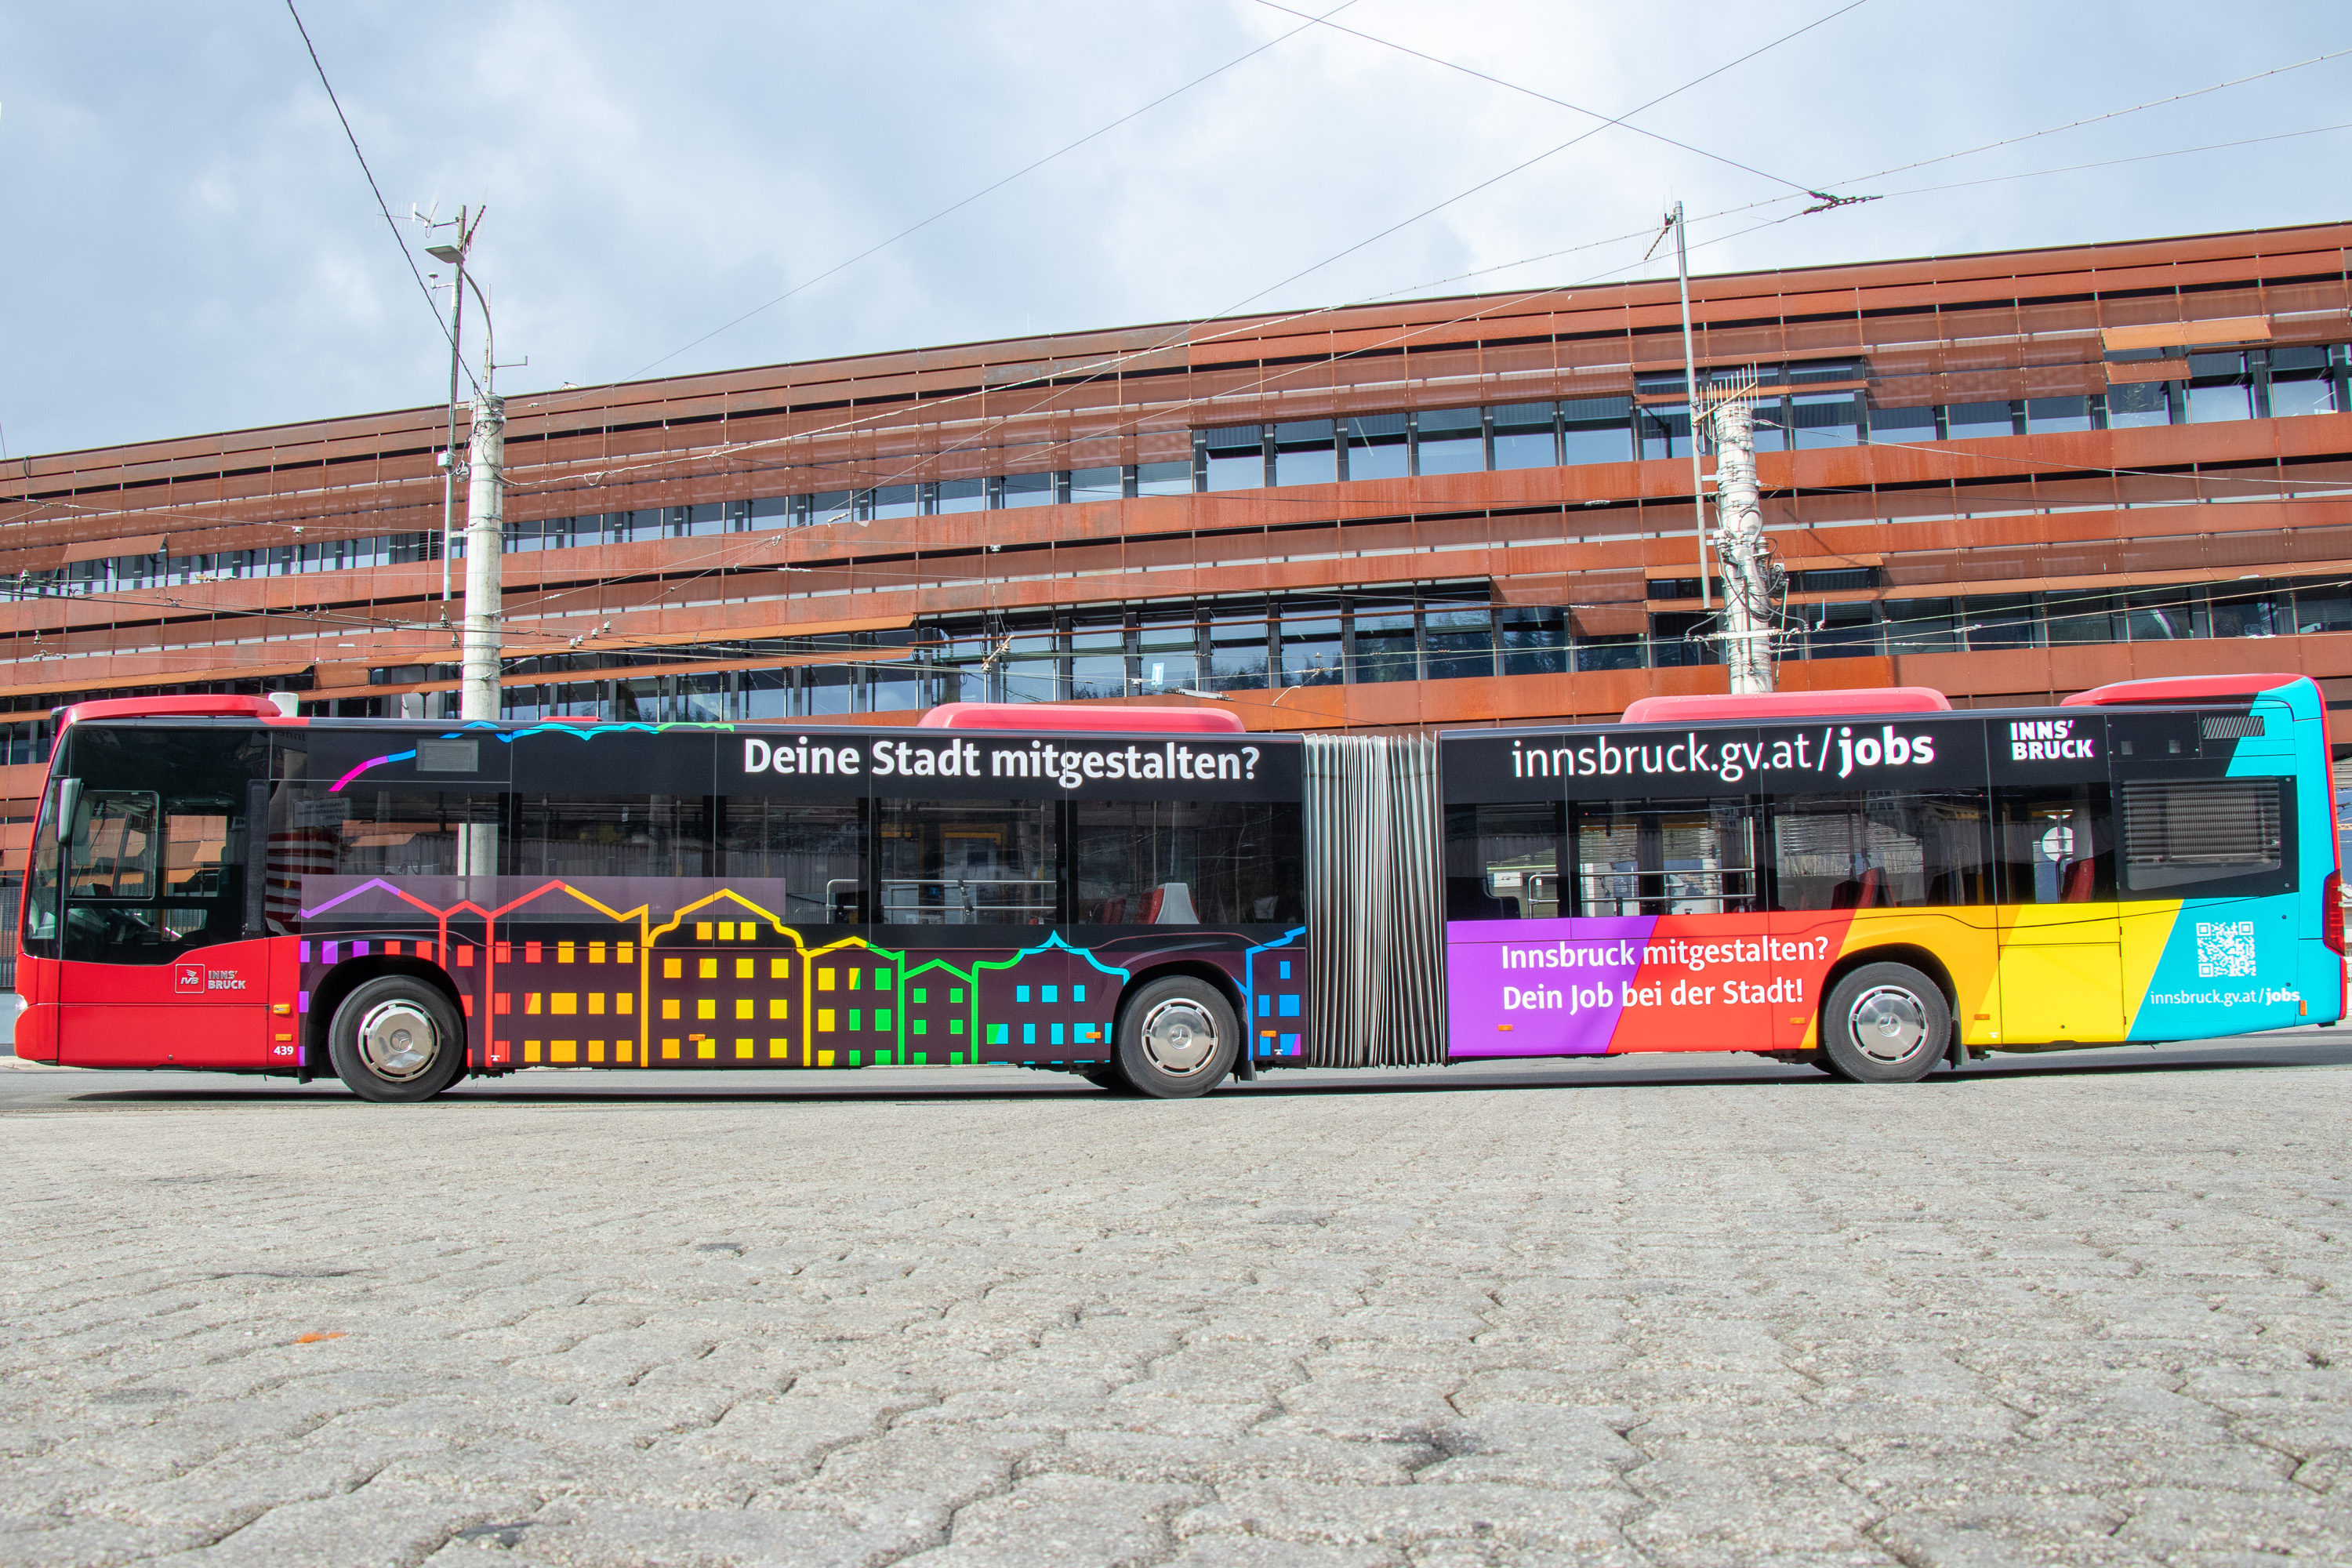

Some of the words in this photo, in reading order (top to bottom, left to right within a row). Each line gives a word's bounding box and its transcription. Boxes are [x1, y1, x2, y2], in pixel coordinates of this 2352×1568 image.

[745, 735, 860, 775] Deine
[871, 738, 981, 777] Stadt
[992, 740, 1261, 789] mitgestalten?
[2012, 739, 2094, 760] BRUCK
[1501, 940, 1635, 969] Innsbruck
[1642, 935, 1829, 971] mitgestalten?
[208, 980, 246, 990] BRUCK
[1503, 984, 1563, 1010] Dein
[1569, 982, 1613, 1016] Job
[1621, 980, 1662, 1007] bei
[1670, 978, 1716, 1005] der
[1722, 977, 1803, 1004] Stadt!
[274, 1045, 294, 1056] 439
